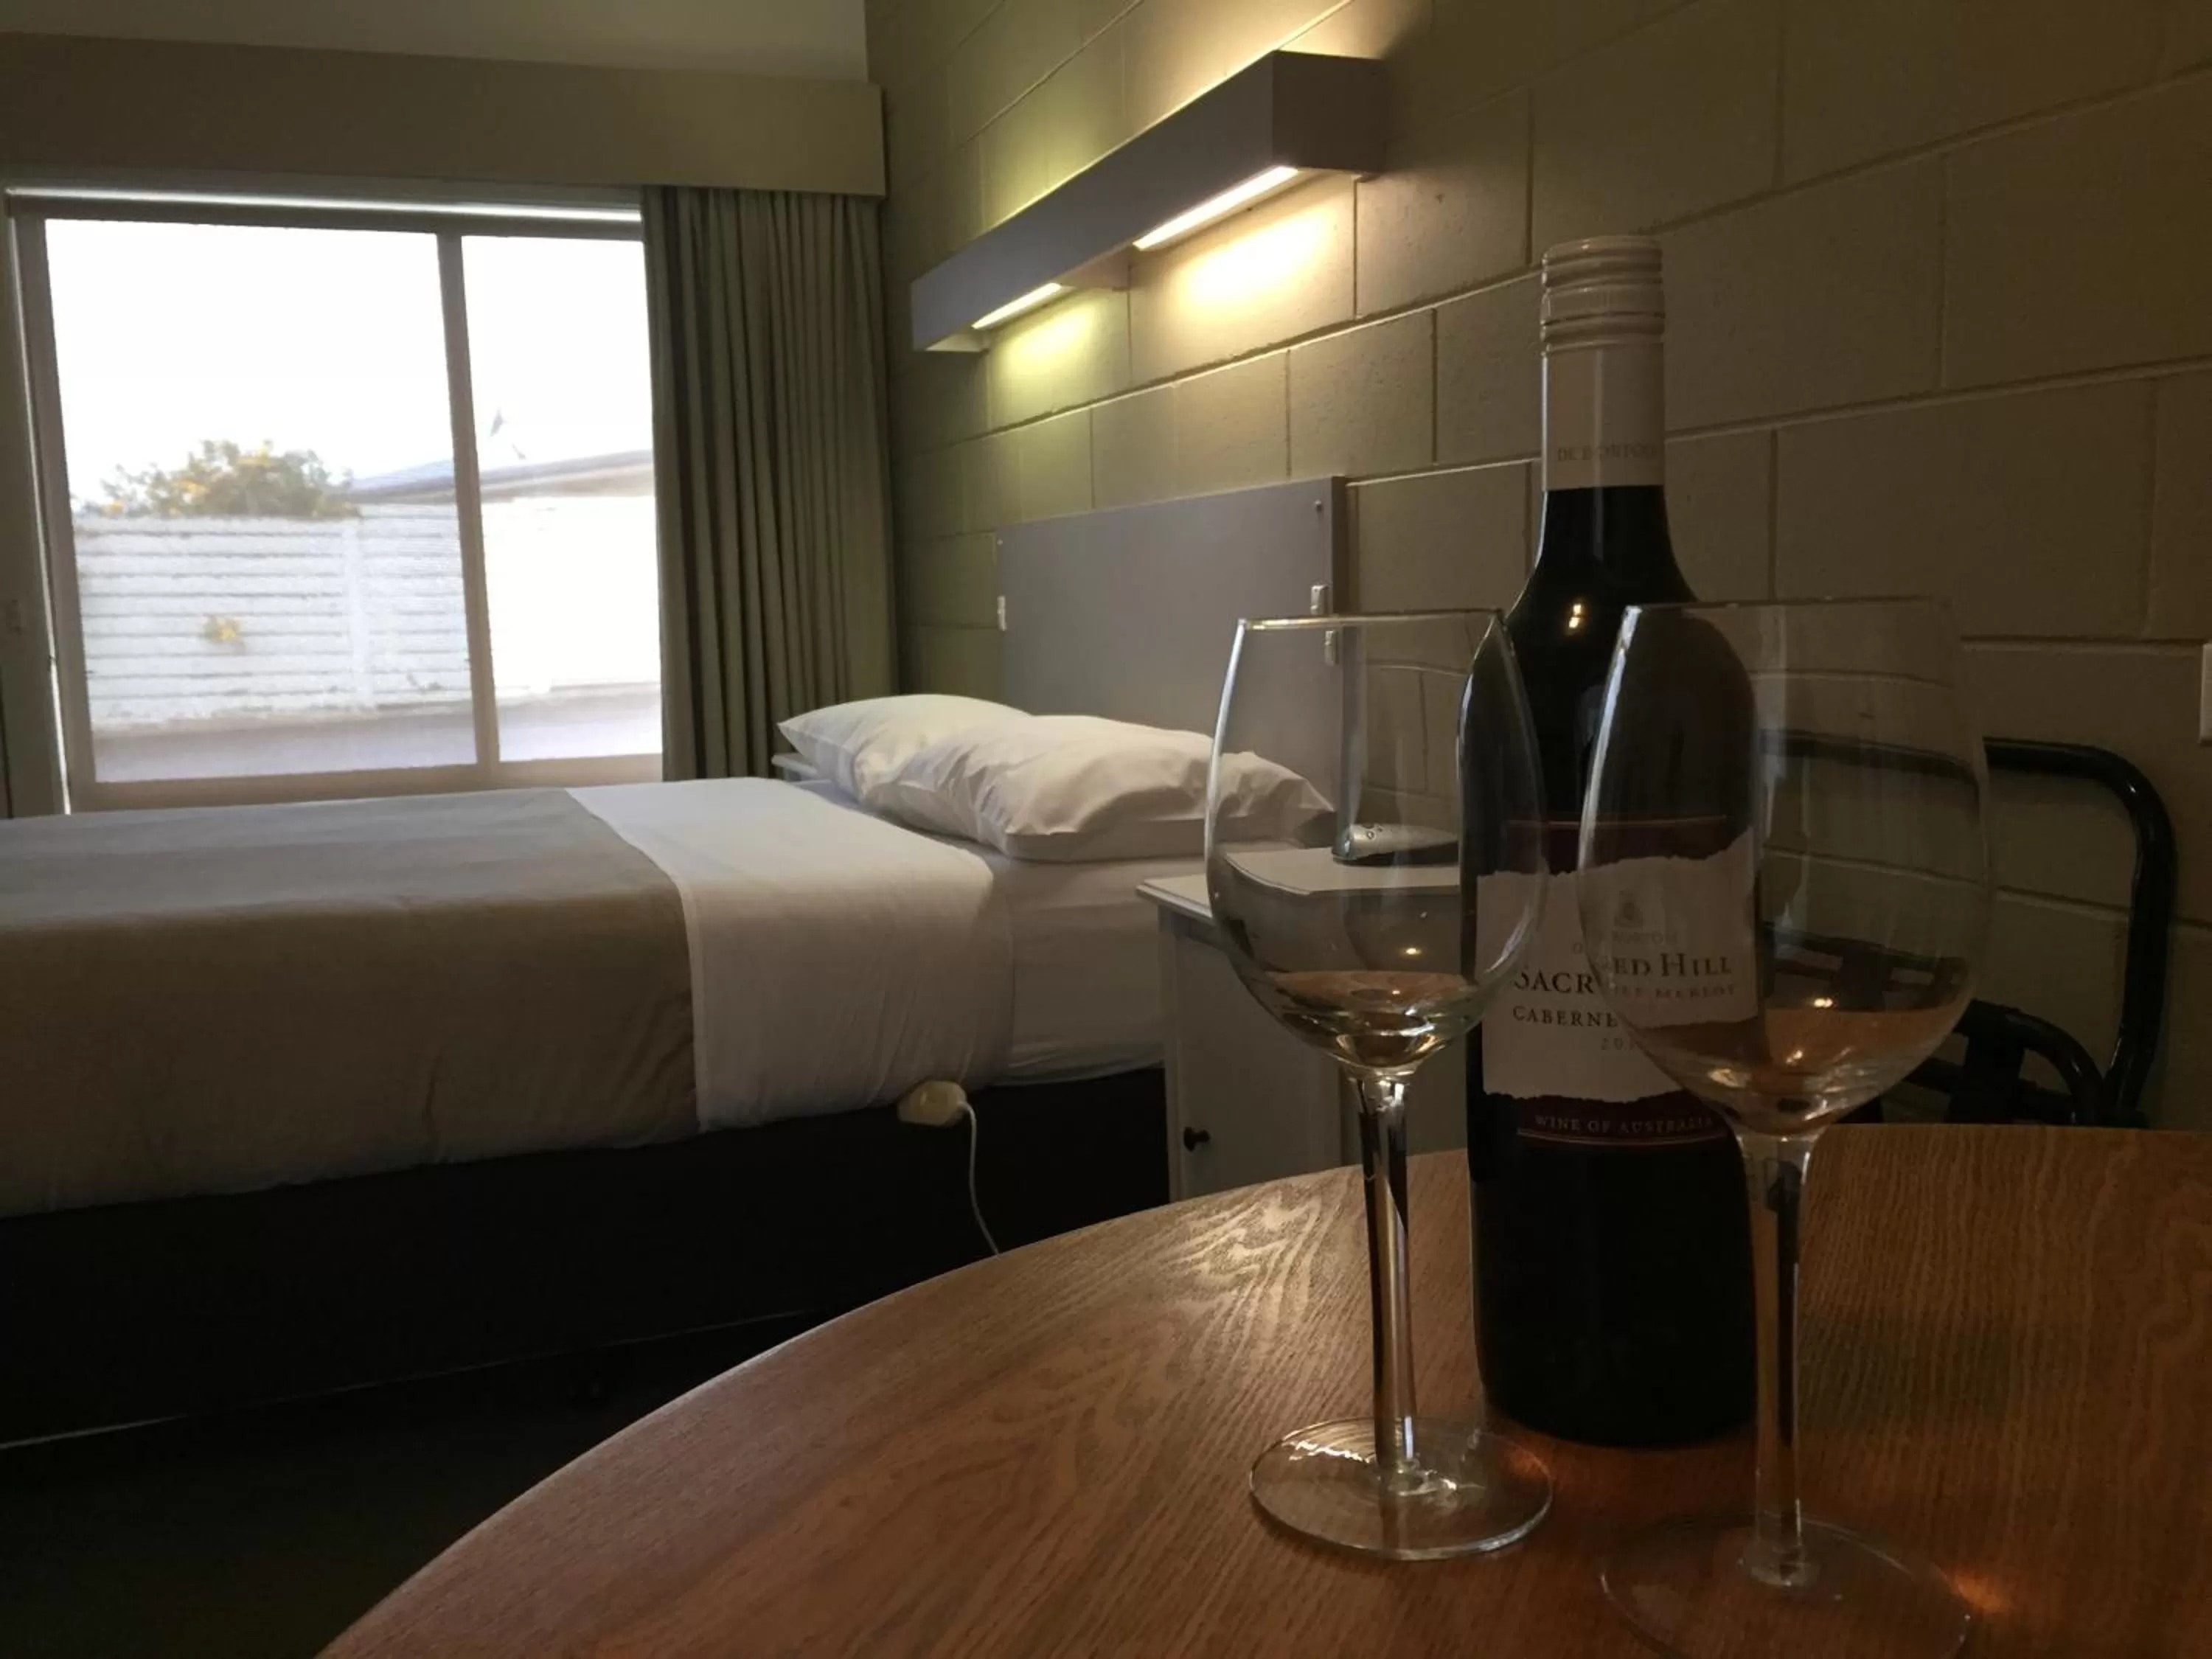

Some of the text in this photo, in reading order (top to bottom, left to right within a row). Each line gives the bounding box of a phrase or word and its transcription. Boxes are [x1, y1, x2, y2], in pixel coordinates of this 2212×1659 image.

[1534, 1114, 1713, 1133] WINE OF AUSTRALIA
